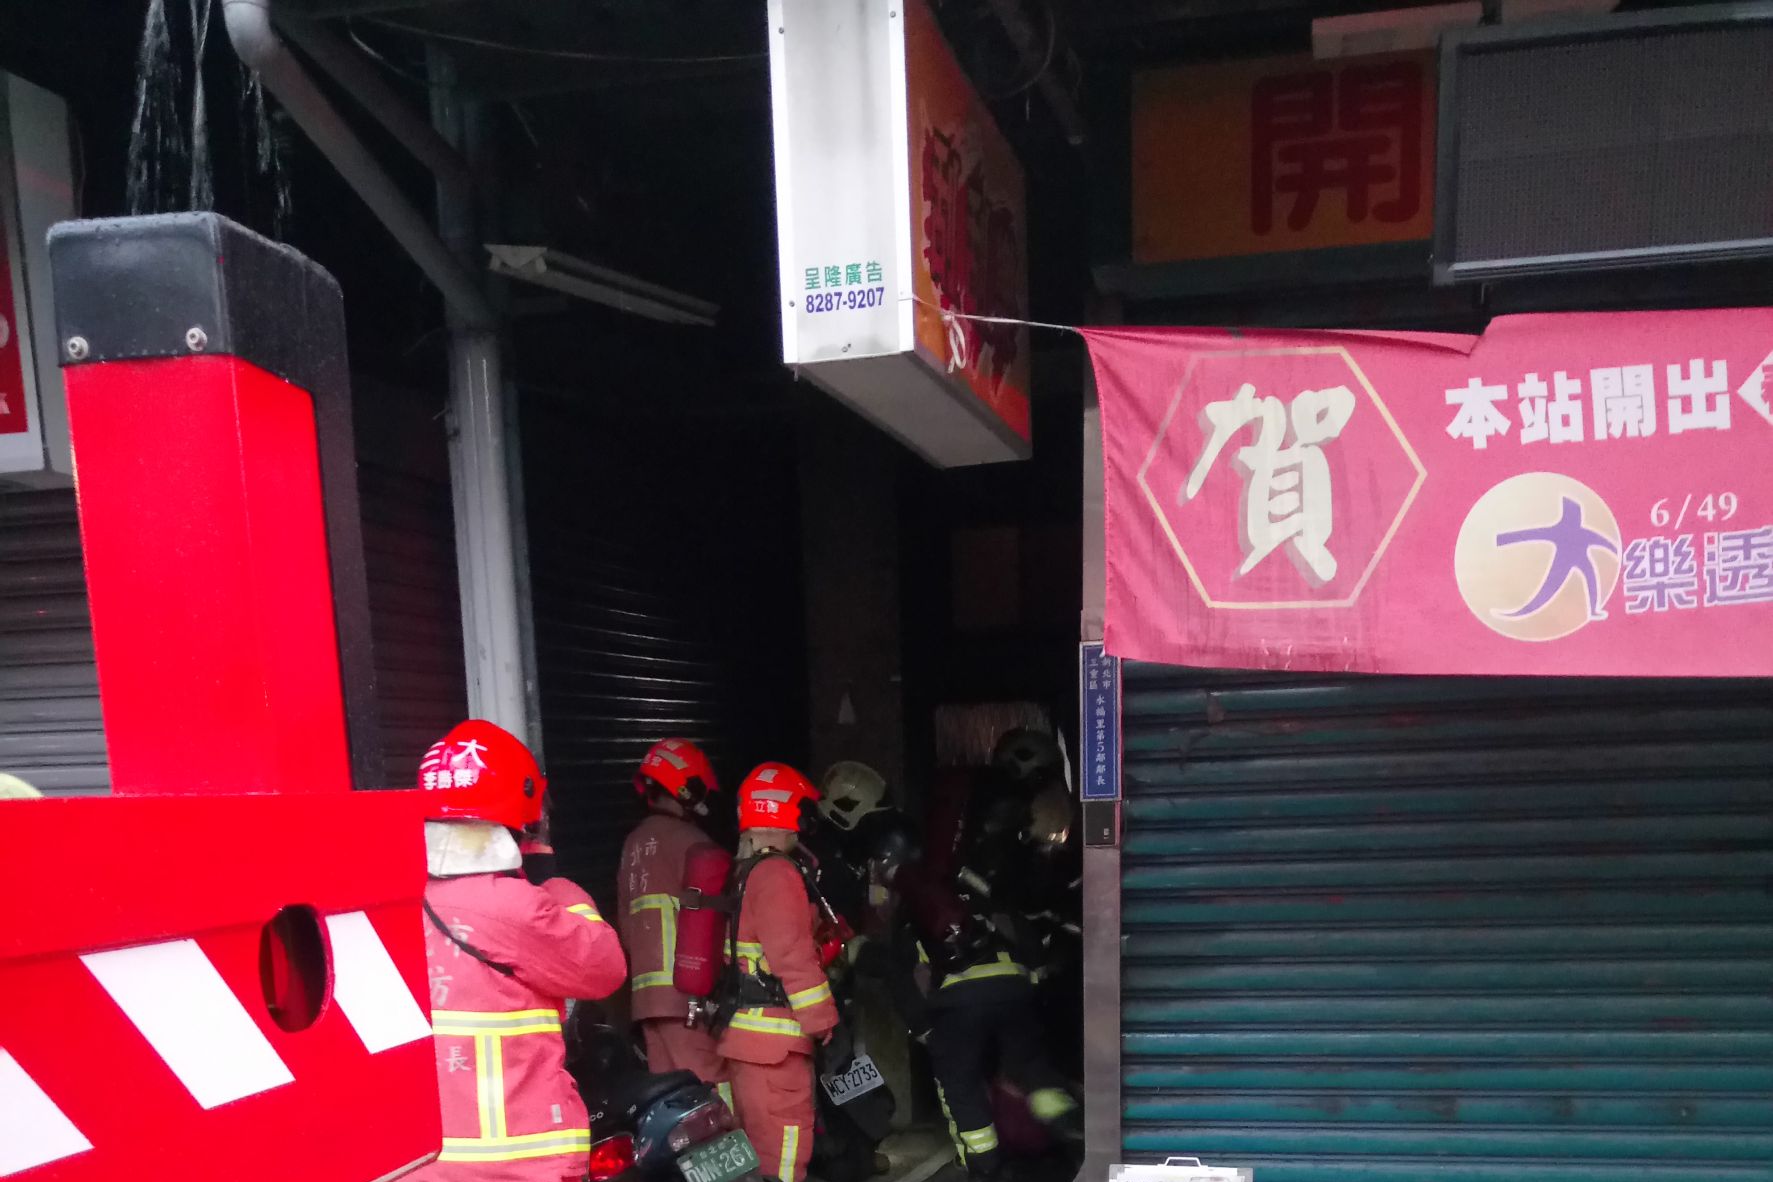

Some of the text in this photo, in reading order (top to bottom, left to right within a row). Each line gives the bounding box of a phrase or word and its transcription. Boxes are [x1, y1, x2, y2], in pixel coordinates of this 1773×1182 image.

[1250, 60, 1423, 236] 開
[804, 260, 883, 290] 呈隆廣告
[805, 286, 885, 313] 8287-9207
[1444, 357, 1732, 451] 本站開出
[1180, 382, 1357, 588] 賀
[1650, 490, 1738, 528] 6/49
[826, 1063, 878, 1098] MCY-2733
